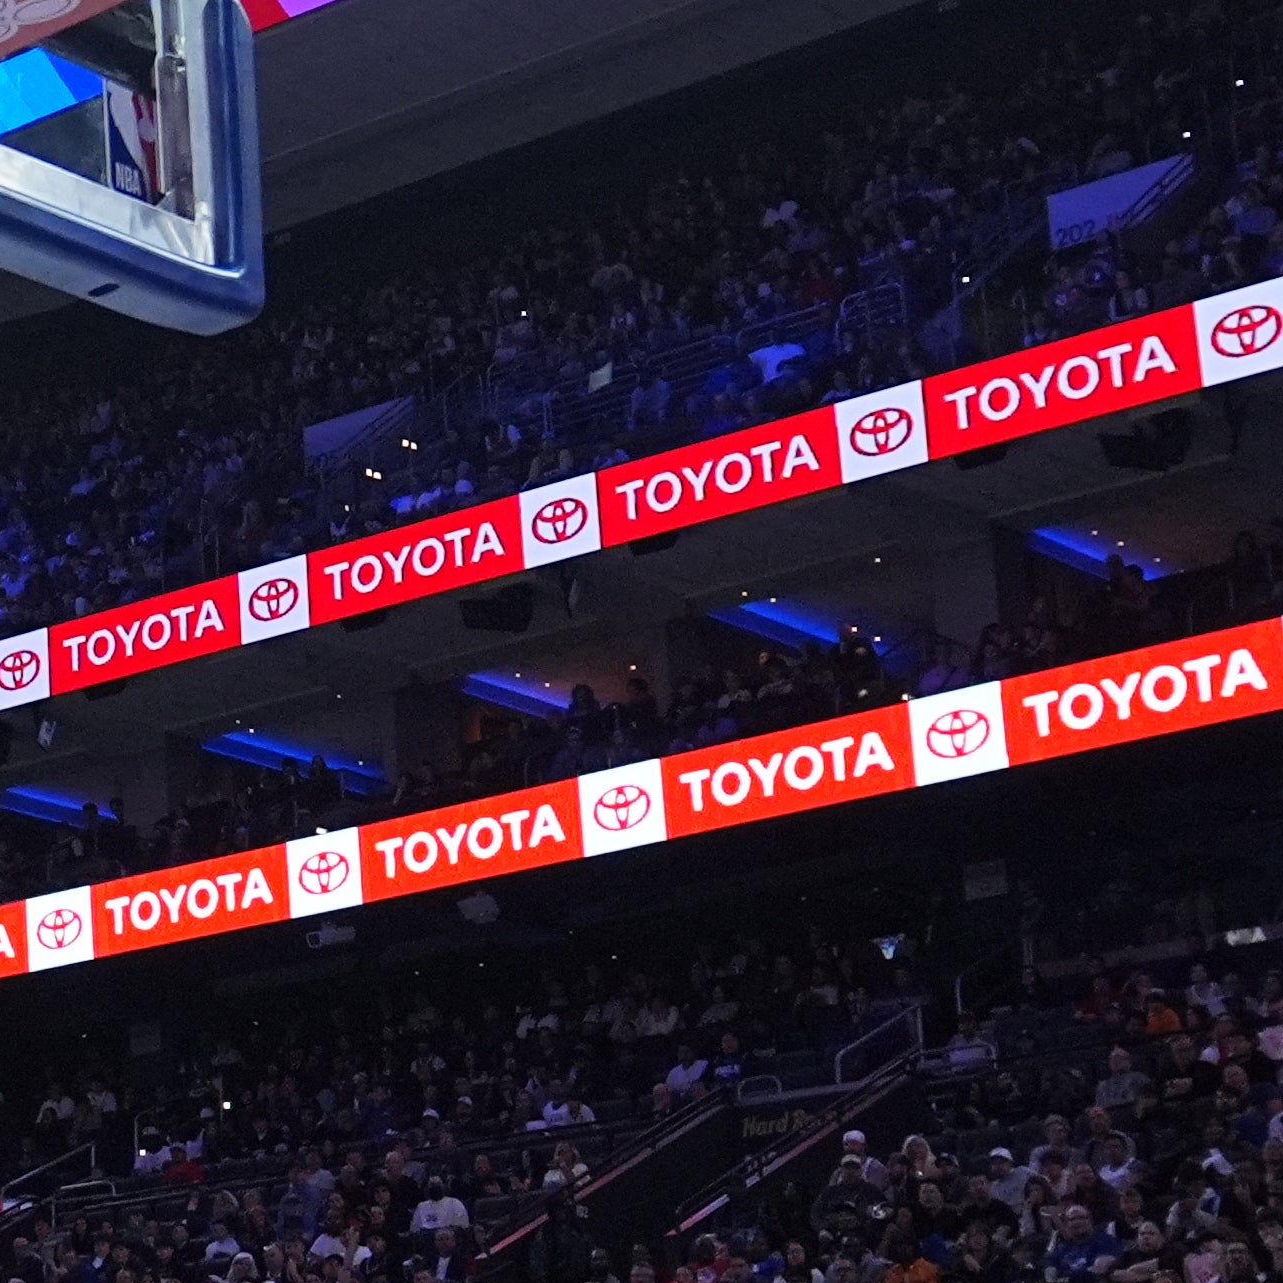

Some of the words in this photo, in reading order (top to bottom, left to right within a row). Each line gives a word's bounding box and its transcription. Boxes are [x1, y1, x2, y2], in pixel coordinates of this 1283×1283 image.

[115, 162, 142, 197] NBA
[945, 336, 1175, 429] TOYOTA
[616, 435, 818, 519] TOYOTA
[324, 523, 504, 599] TOYOTA
[63, 600, 223, 671] TOYOTA
[1023, 649, 1267, 737] TOYOTA
[680, 732, 894, 812] TOYOTA
[375, 804, 566, 878] TOYOTA
[105, 868, 273, 934] TOYOTA
